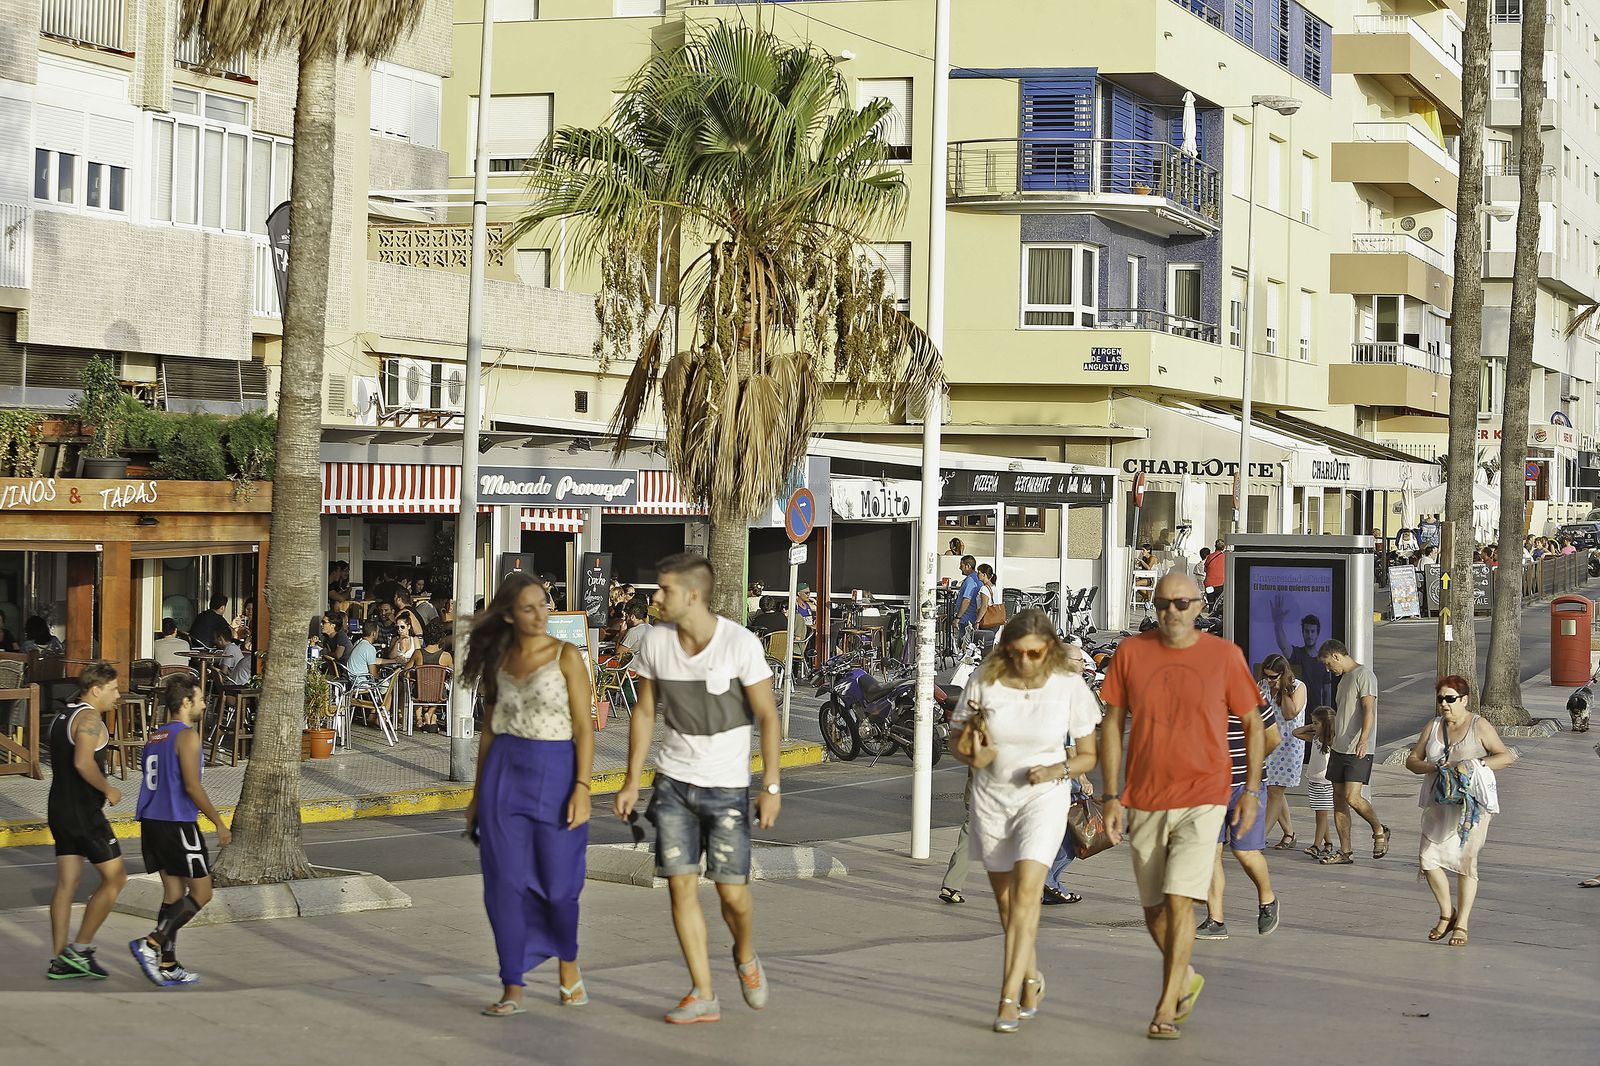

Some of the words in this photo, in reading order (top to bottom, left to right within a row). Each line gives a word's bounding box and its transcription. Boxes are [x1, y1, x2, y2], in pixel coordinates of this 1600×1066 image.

[1091, 348, 1122, 356] VIRGEN
[1083, 363, 1129, 371] ANGUSTIAS
[1122, 458, 1274, 478] CHARLOTTE
[1311, 457, 1351, 481] CHARLOTTE
[69, 486, 82, 504] &
[99, 480, 158, 510] TAPAS
[480, 474, 552, 496] Mercado
[1254, 583, 1259, 591] El
[1289, 584, 1310, 592] quieres
[146, 754, 159, 791] 8
